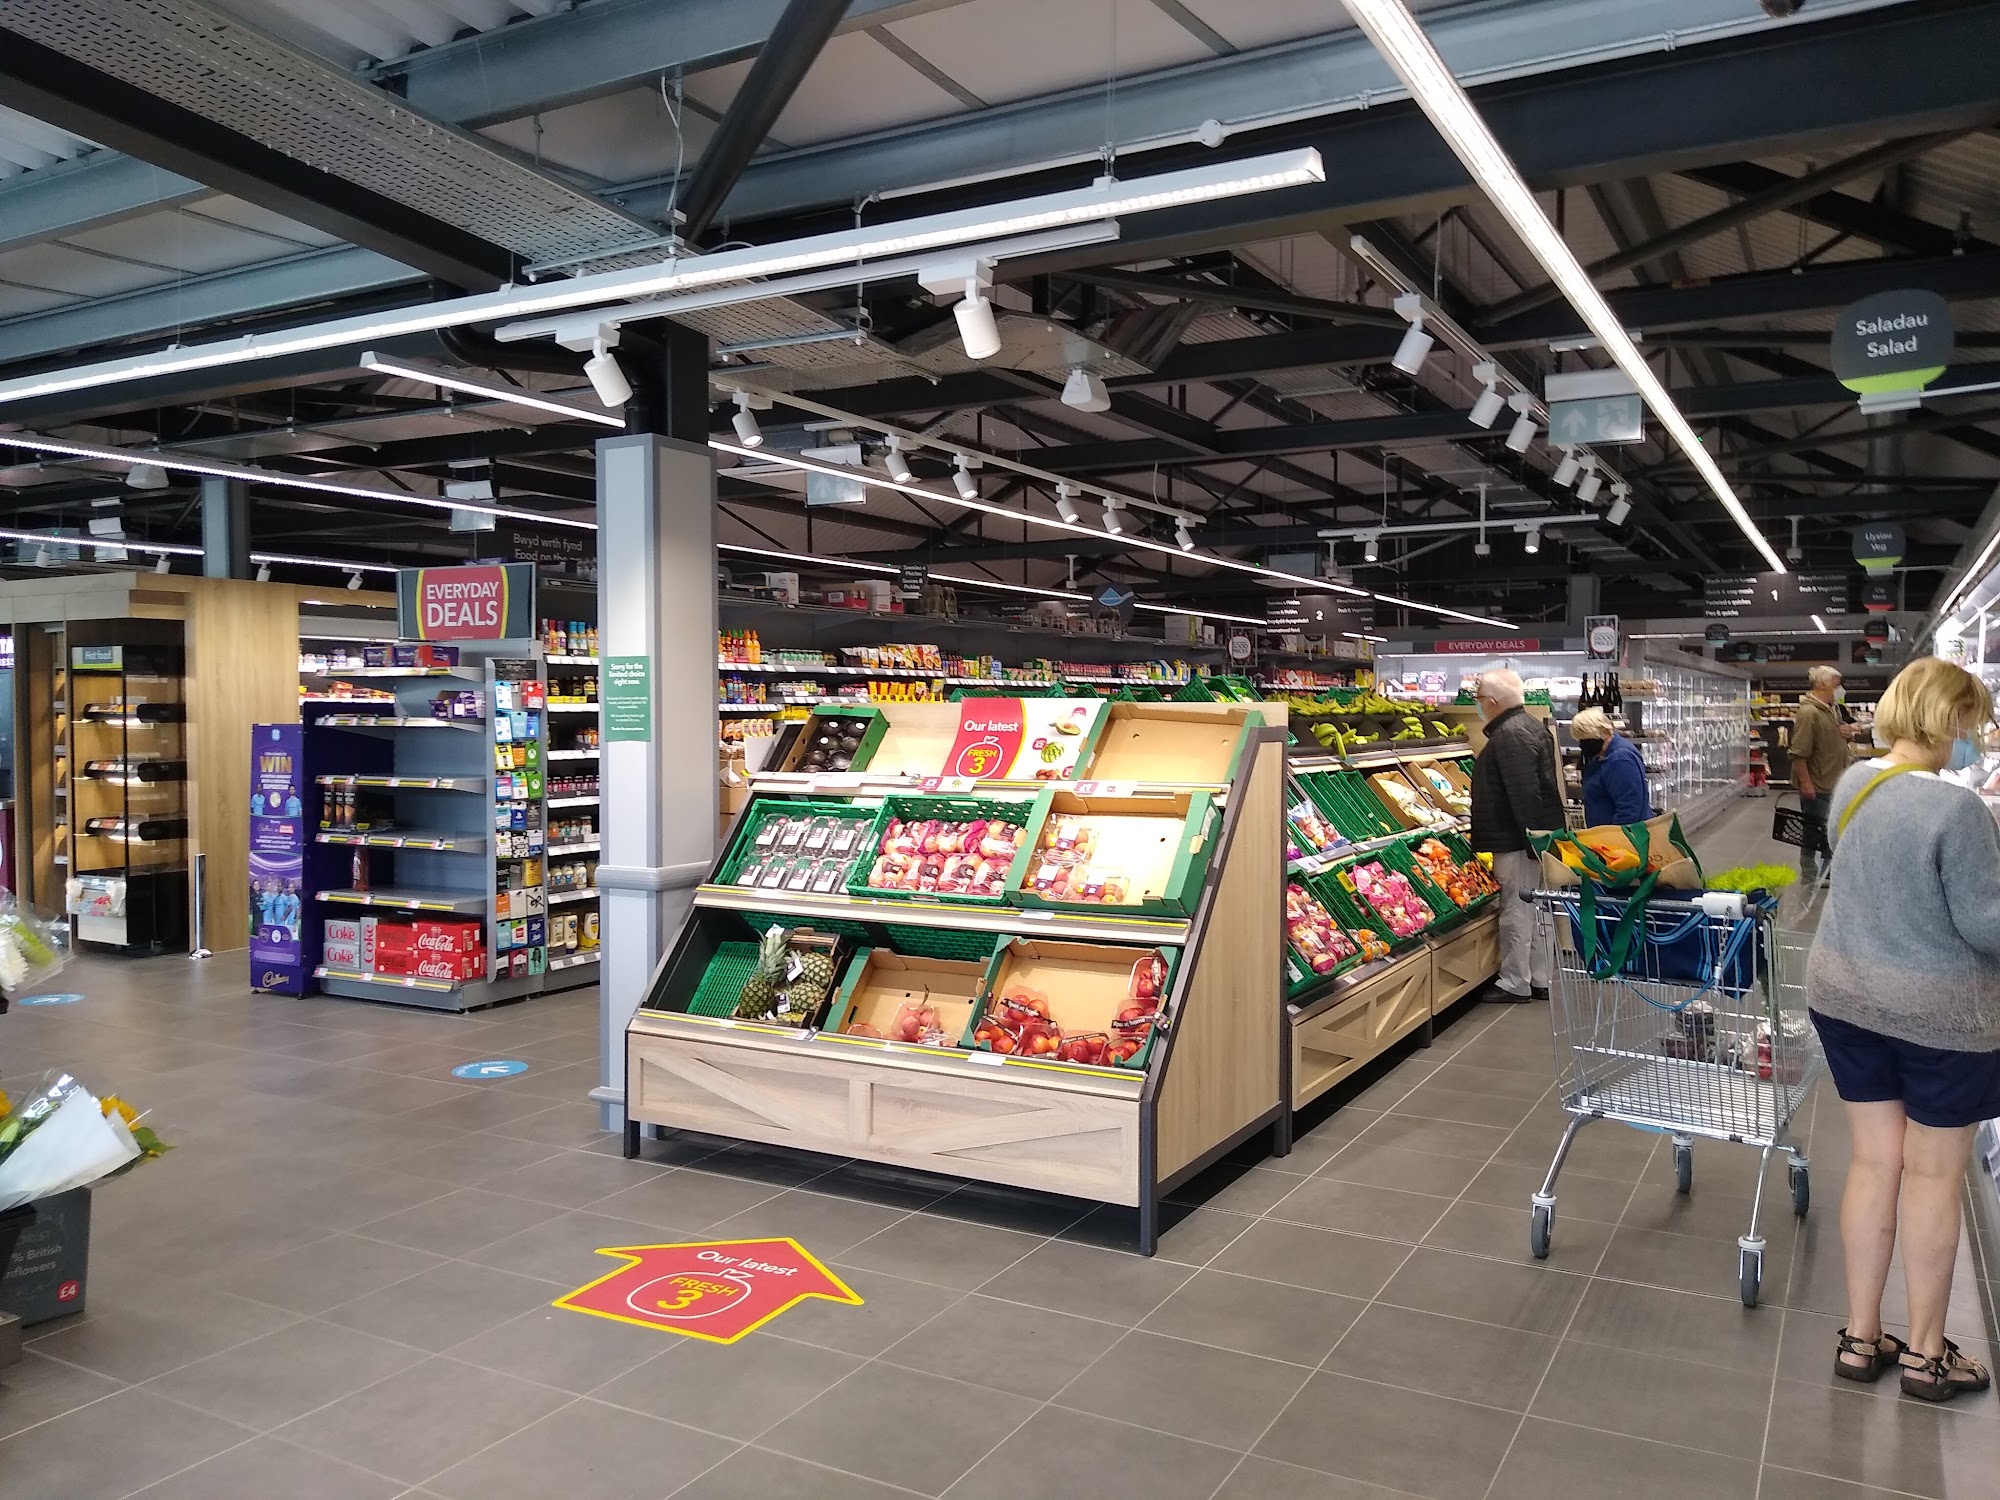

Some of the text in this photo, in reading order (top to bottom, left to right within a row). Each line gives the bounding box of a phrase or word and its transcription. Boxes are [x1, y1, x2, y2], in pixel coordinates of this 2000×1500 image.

[1855, 312, 1929, 337] Saladau
[1866, 334, 1919, 359] Salad
[513, 532, 583, 553] Bwyd wrth fynd
[514, 548, 539, 561] Food
[426, 581, 500, 600] EVERYDAY
[1770, 589, 1779, 602] 1
[426, 600, 499, 628] DEALS
[1315, 610, 1324, 621] 2
[1448, 640, 1526, 651] EVERYDAY DEALS
[98, 649, 112, 661] food
[610, 662, 643, 671] Sorry for the
[613, 678, 628, 687] right
[963, 719, 1020, 732] Our latest
[966, 748, 998, 758] FRESH
[259, 756, 292, 773] WIN
[968, 756, 986, 774] 3
[328, 923, 356, 941] Coke
[363, 924, 374, 964] Coke
[417, 932, 456, 952] Coca-Cola
[327, 945, 354, 963] Coke
[417, 959, 455, 979] Coca-Cola
[26, 1244, 63, 1261] British
[695, 1250, 799, 1277] Our latest
[59, 1284, 78, 1300] £4
[667, 1275, 741, 1297] FRESH
[656, 1289, 704, 1310] 3
